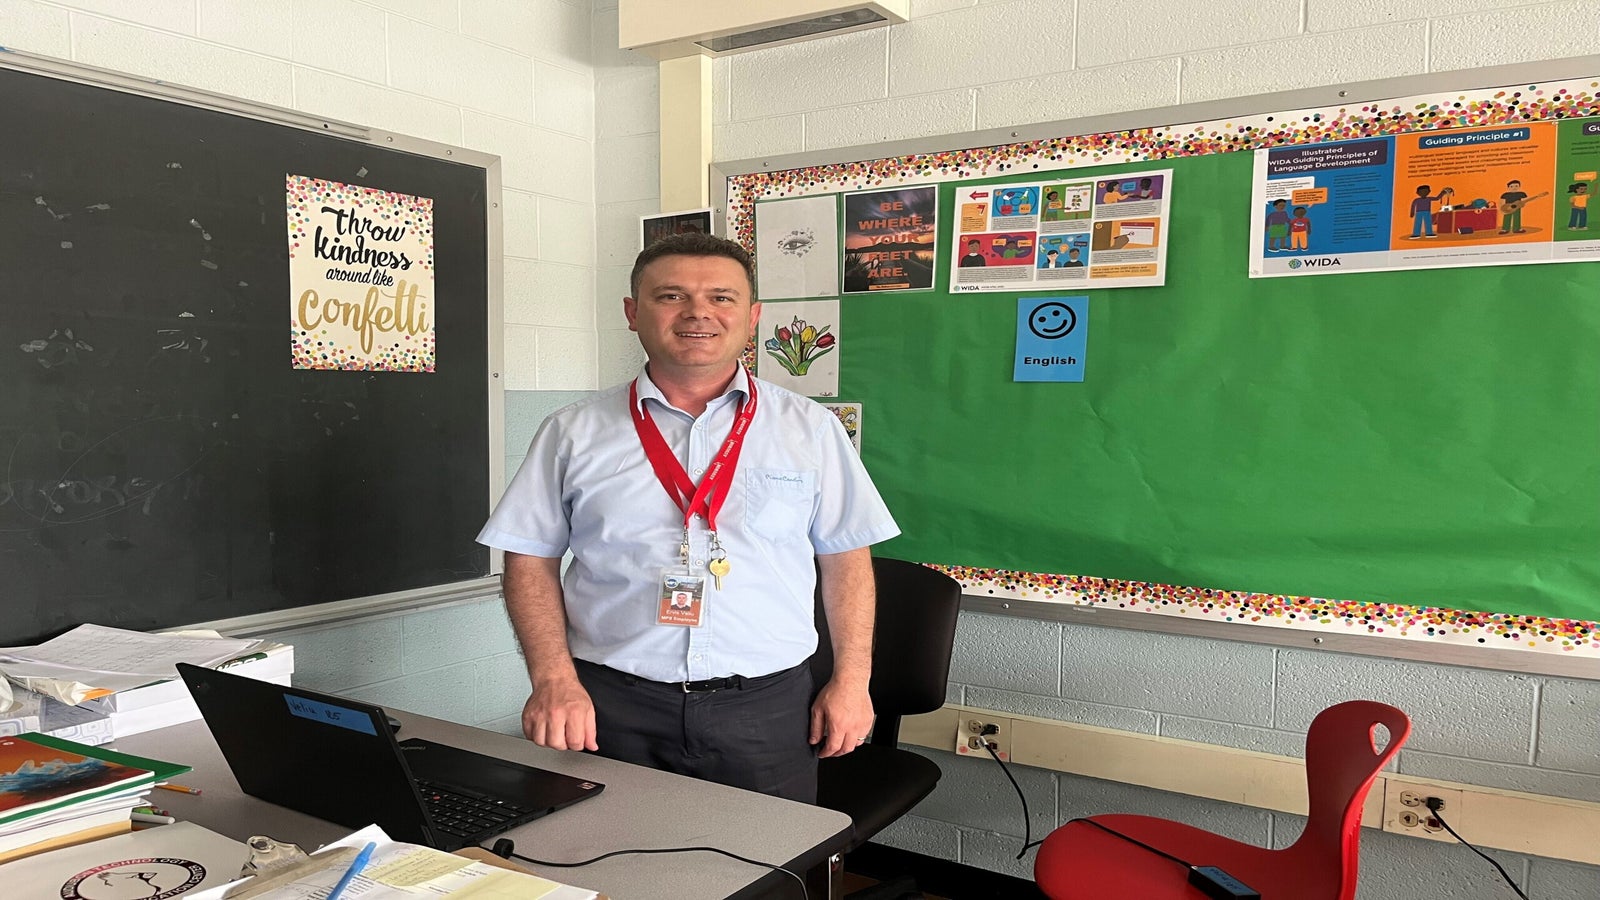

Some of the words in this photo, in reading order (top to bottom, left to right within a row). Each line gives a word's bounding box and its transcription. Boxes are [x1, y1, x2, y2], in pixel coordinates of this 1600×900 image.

[1425, 136, 1463, 146] Guiding
[1466, 132, 1510, 142] Principle
[1301, 147, 1343, 156] Illustrated
[1292, 156, 1324, 164] Guiding
[1326, 152, 1367, 161] Principles
[1274, 162, 1313, 172] Language
[1315, 157, 1371, 168] Development
[880, 201, 903, 212] BE
[858, 216, 923, 230] WHERE
[868, 233, 920, 246] YOUR
[314, 225, 414, 271] kindness
[868, 249, 913, 261] FEET
[1303, 257, 1341, 267] WIDA
[325, 267, 372, 284] around
[372, 268, 394, 287] like
[867, 267, 908, 279] ARE.
[1023, 356, 1077, 367] English
[94, 857, 188, 871] TECHNOLOGY
